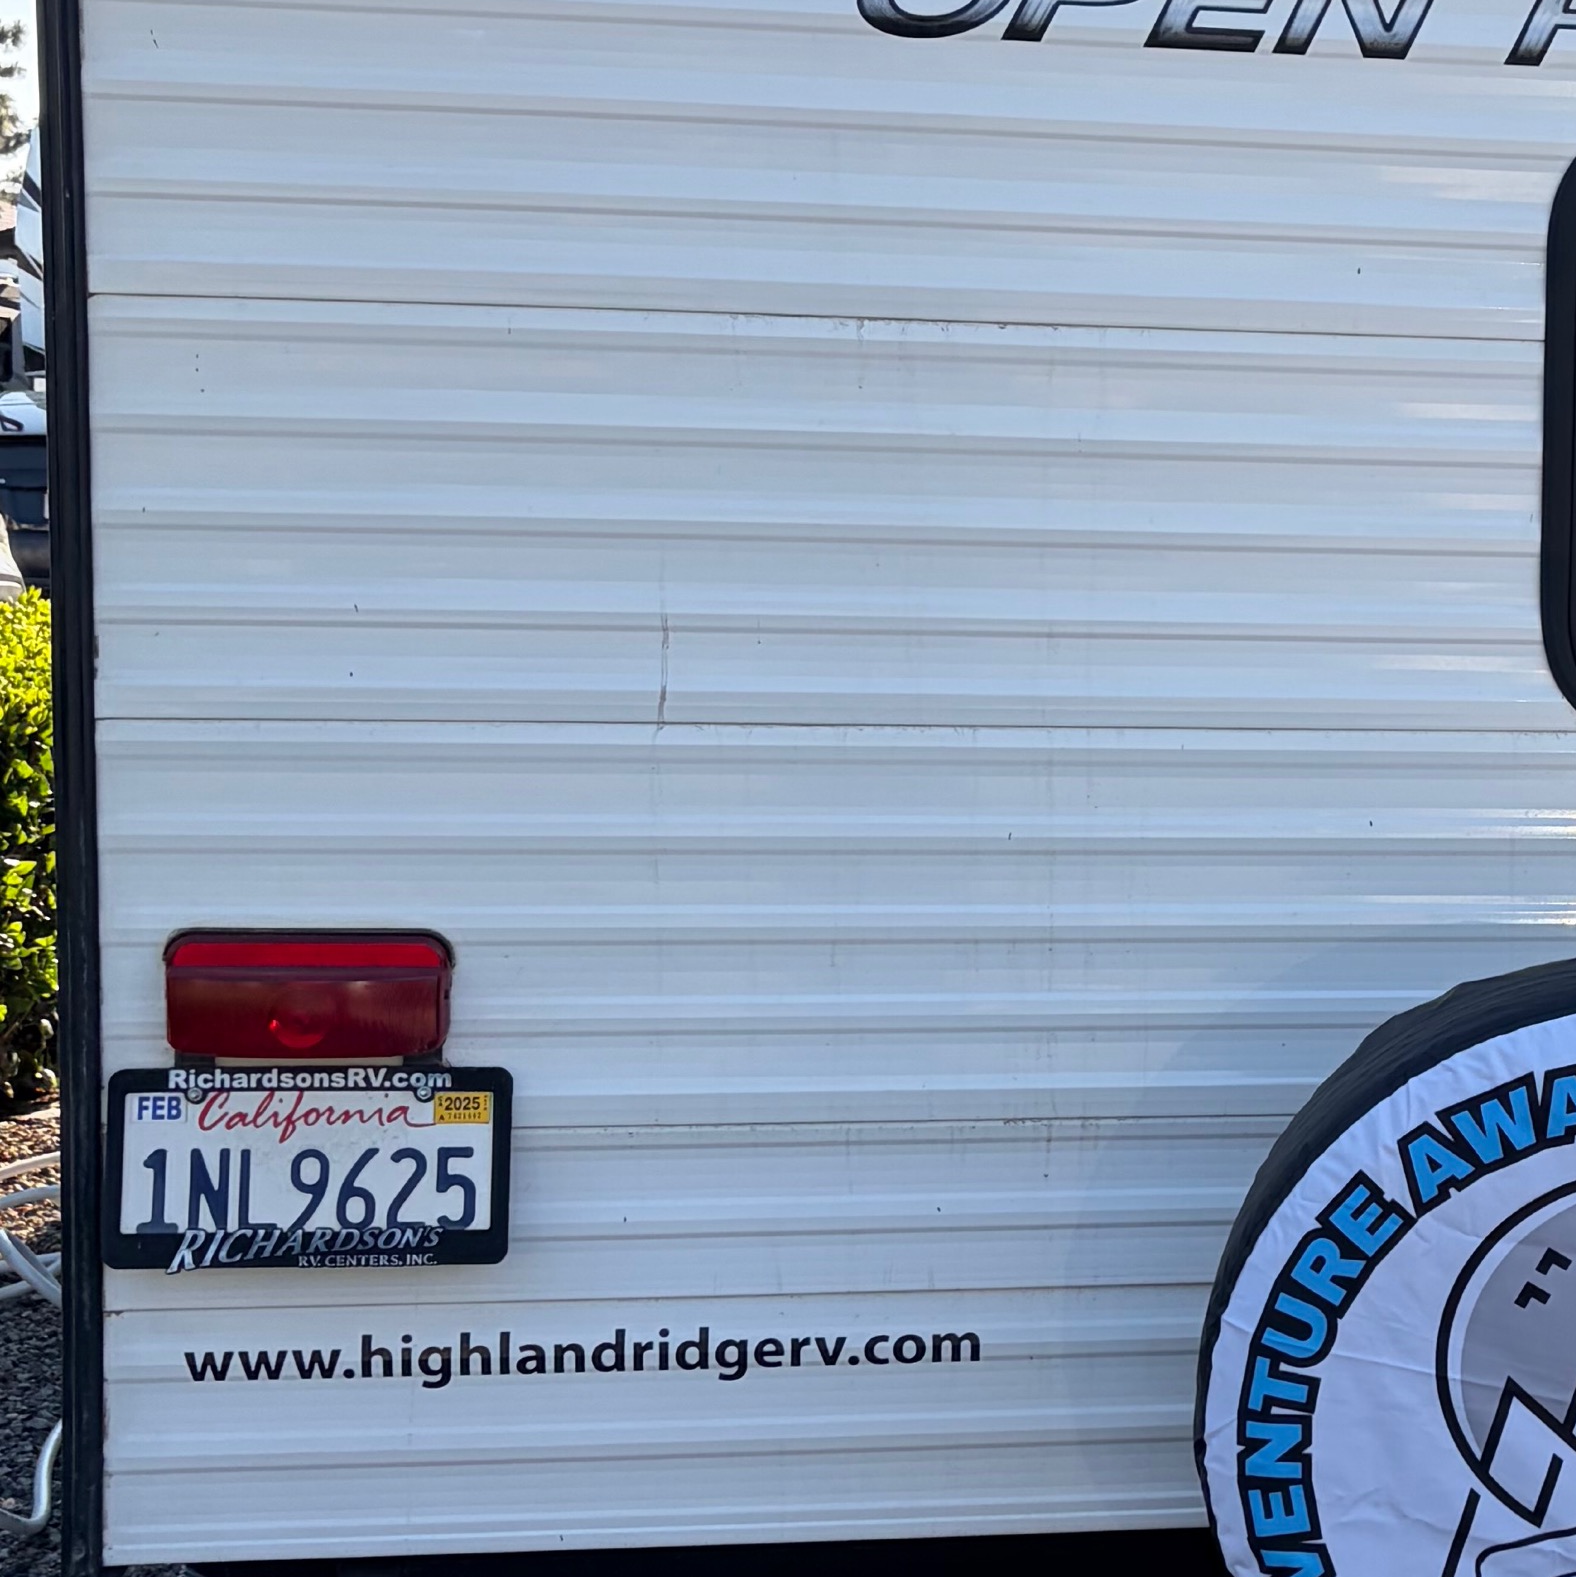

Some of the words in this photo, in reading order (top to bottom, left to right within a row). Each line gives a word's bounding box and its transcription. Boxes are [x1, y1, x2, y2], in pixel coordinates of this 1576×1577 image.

[168, 1067, 452, 1089] RichardsonsRV.com
[136, 1096, 182, 1121] FEB
[198, 1088, 436, 1143] California
[444, 1096, 481, 1111] 2025
[136, 1147, 476, 1235] 1NL9625
[165, 1227, 444, 1274] RICHARDSON'S
[406, 1252, 438, 1266] INC.
[183, 1326, 982, 1390] www.highlandridgerv.com
